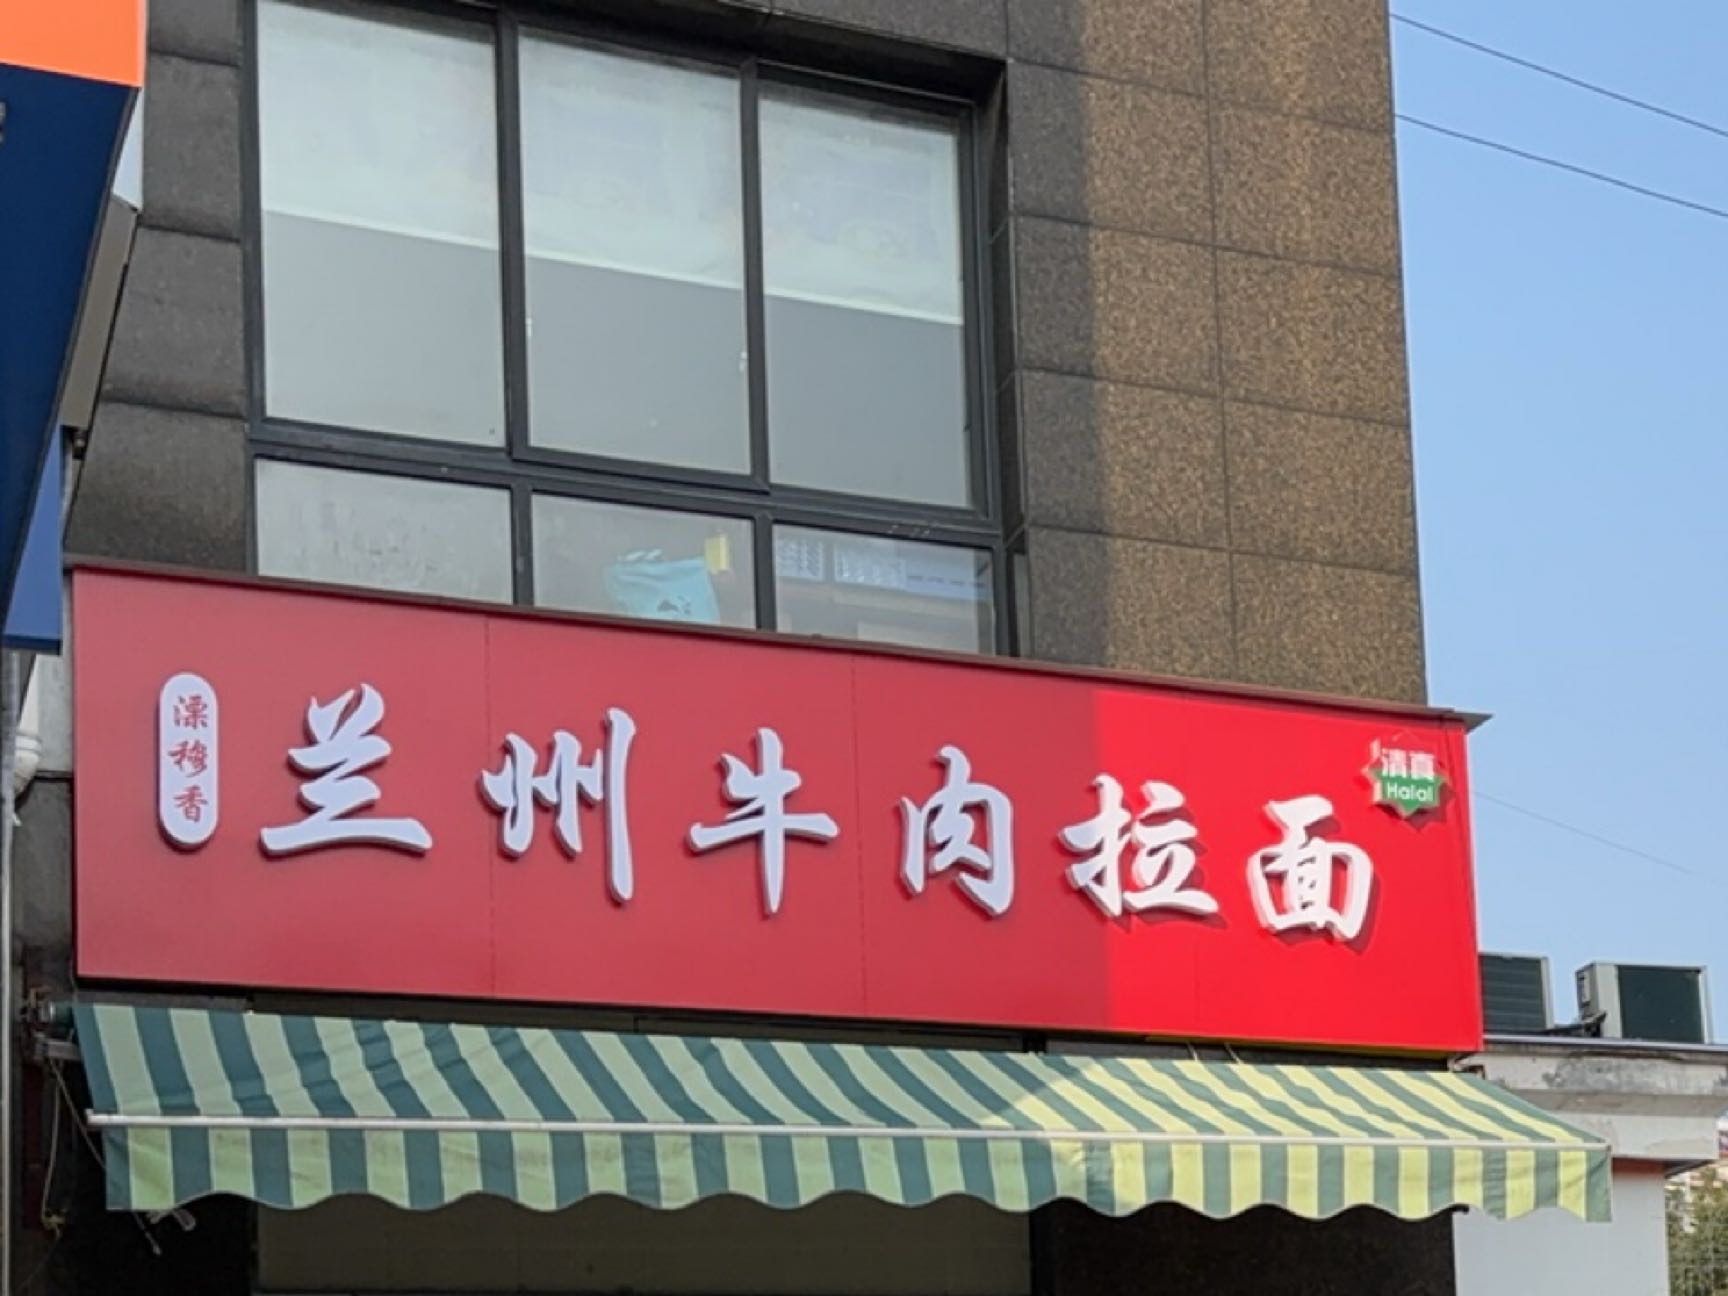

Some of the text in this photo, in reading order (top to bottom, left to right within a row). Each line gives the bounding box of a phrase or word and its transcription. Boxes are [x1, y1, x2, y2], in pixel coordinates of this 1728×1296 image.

[1381, 748, 1435, 782] 清真
[1386, 782, 1434, 802] Halal
[258, 681, 1375, 941] 兰州牛肉拉面
